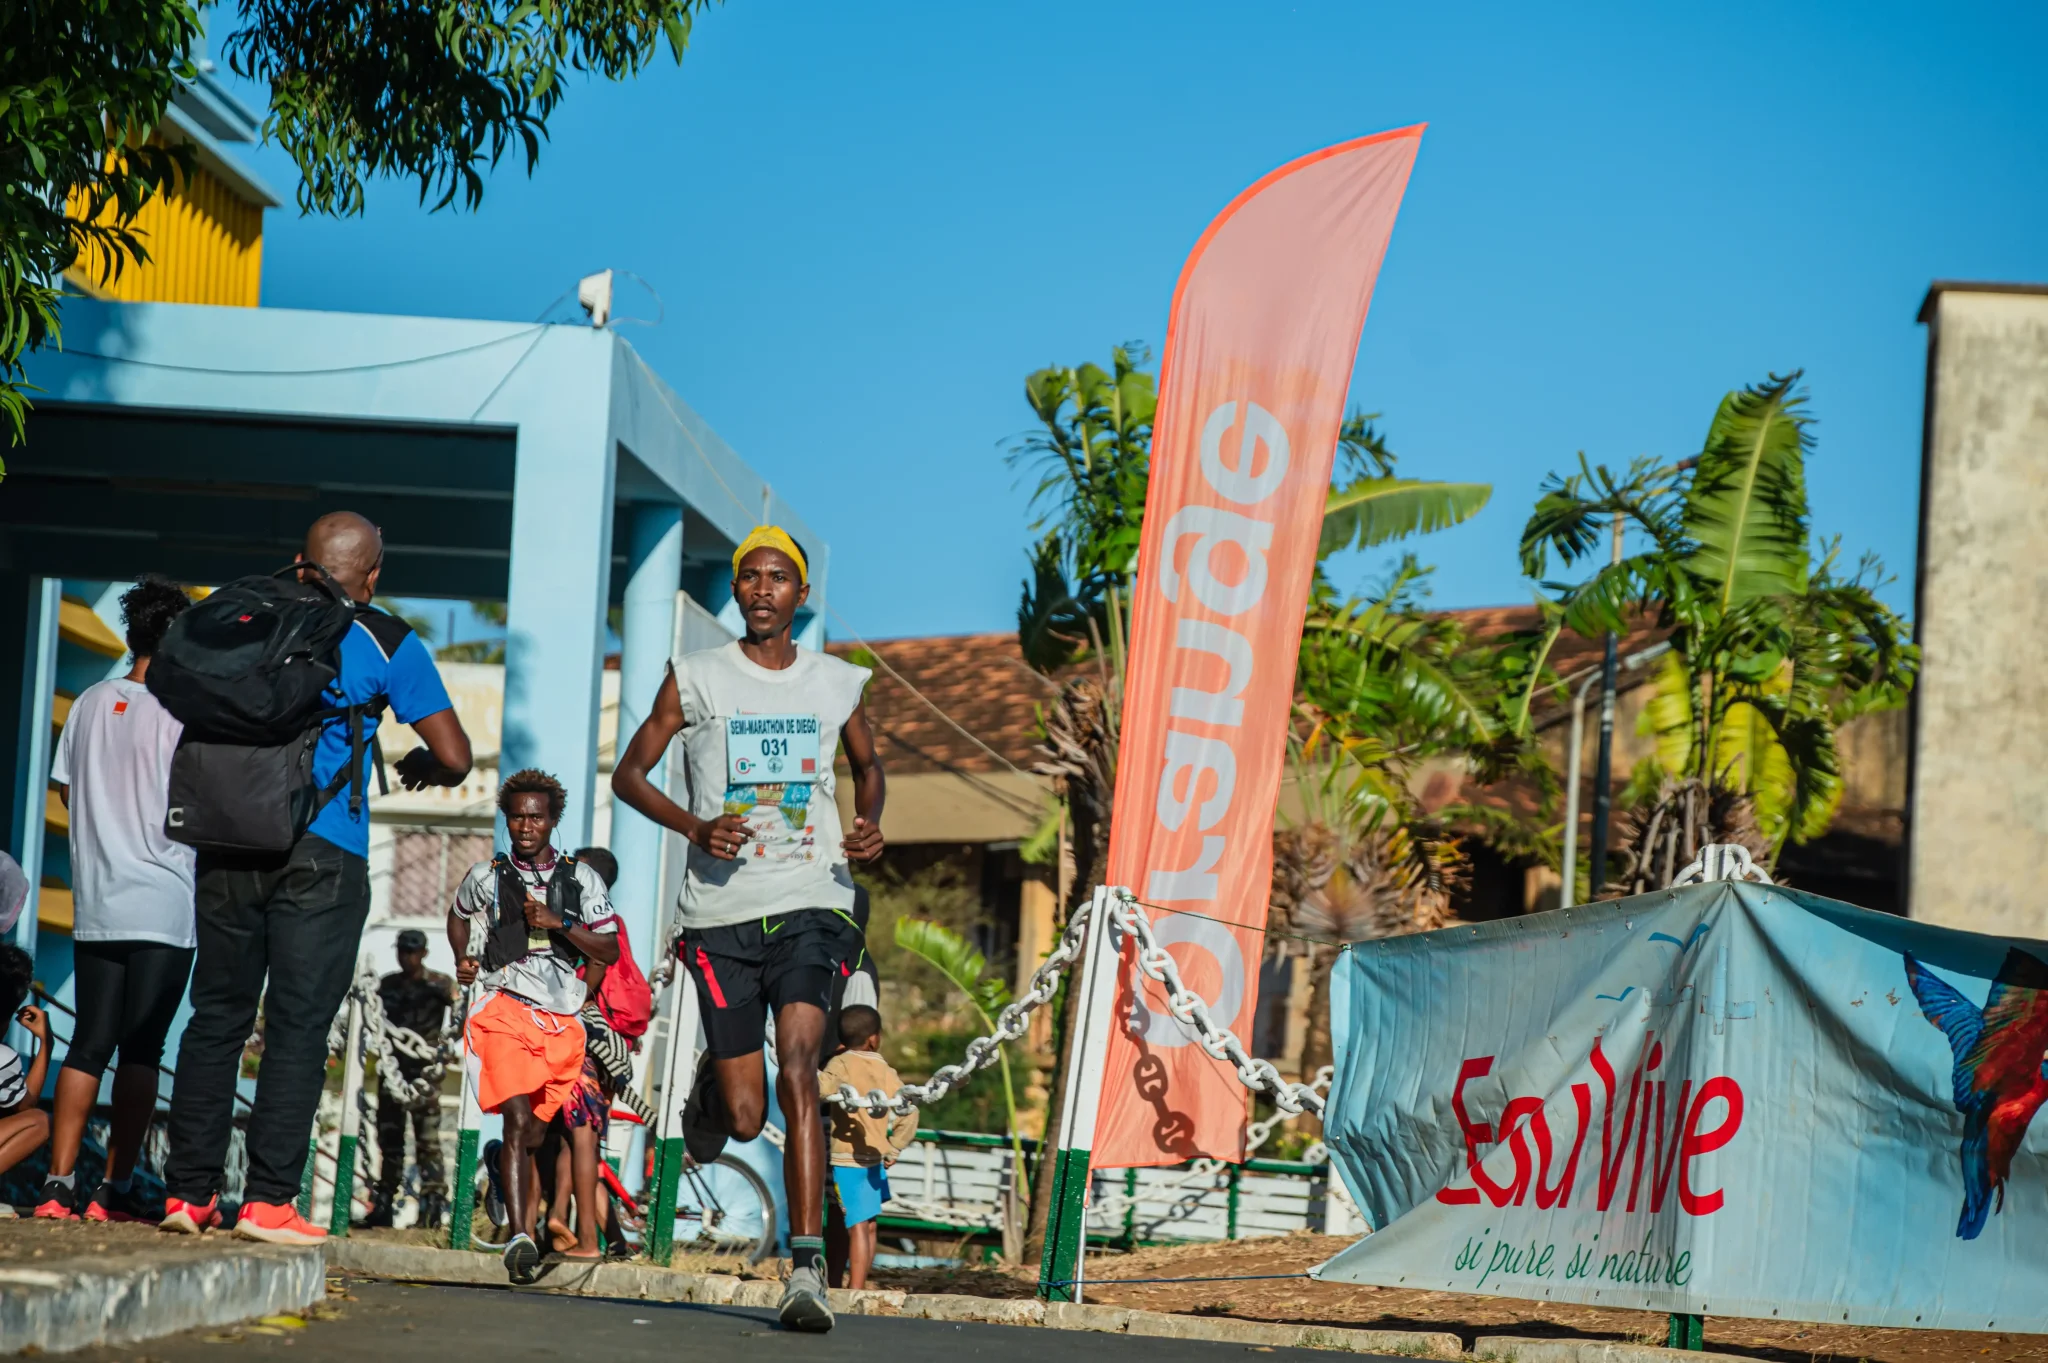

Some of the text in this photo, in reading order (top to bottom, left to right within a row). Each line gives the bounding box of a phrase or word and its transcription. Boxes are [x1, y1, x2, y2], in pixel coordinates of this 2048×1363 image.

[730, 718, 817, 735] SEMI-MARATHON DE DIEGO
[761, 738, 788, 756] 031
[1455, 1228, 1694, 1289] si pure, si nature
